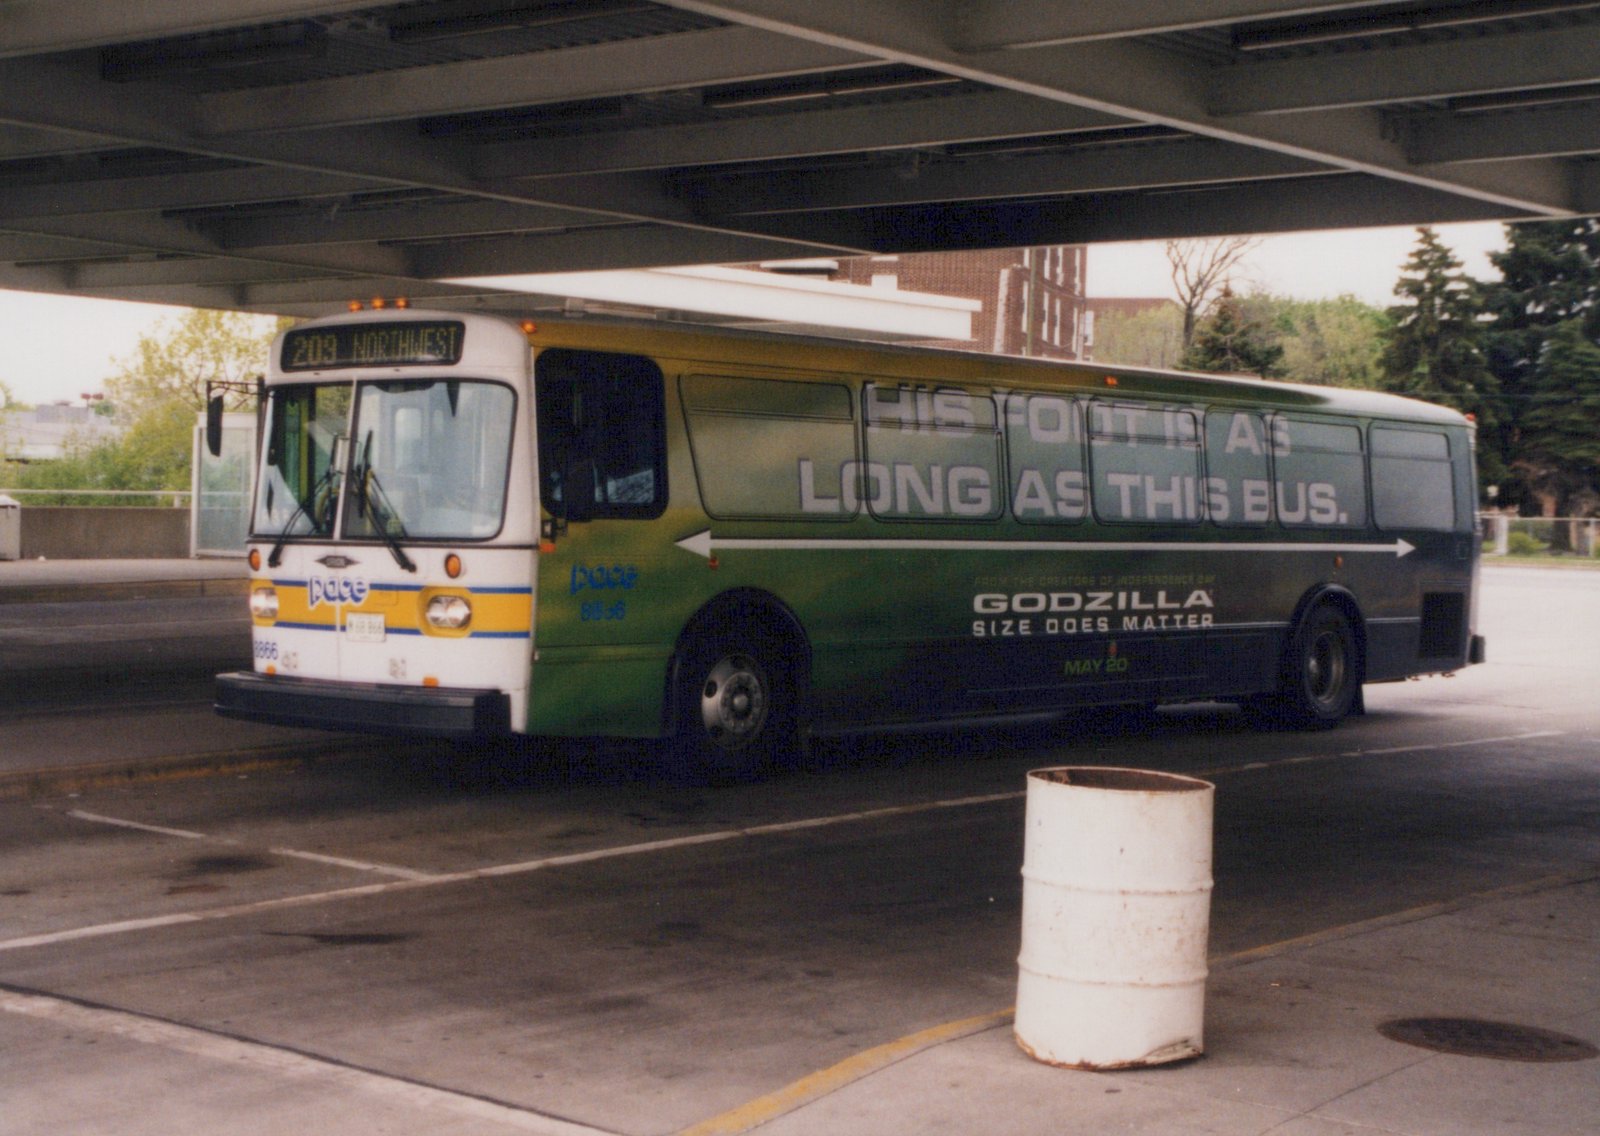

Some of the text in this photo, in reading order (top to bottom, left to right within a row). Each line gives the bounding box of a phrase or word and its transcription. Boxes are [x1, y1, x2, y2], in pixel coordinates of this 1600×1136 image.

[352, 326, 458, 362] NORTHWEST
[866, 382, 976, 440] HIS
[1225, 408, 1292, 458] AS
[798, 456, 1349, 526] LONG AS THIS BUS.
[308, 575, 370, 607] pace
[569, 564, 640, 595] pace
[973, 589, 1215, 614] GODZILLA
[972, 613, 1215, 637] SIZE DOES MATTER
[1064, 656, 1129, 676] MAY 20
